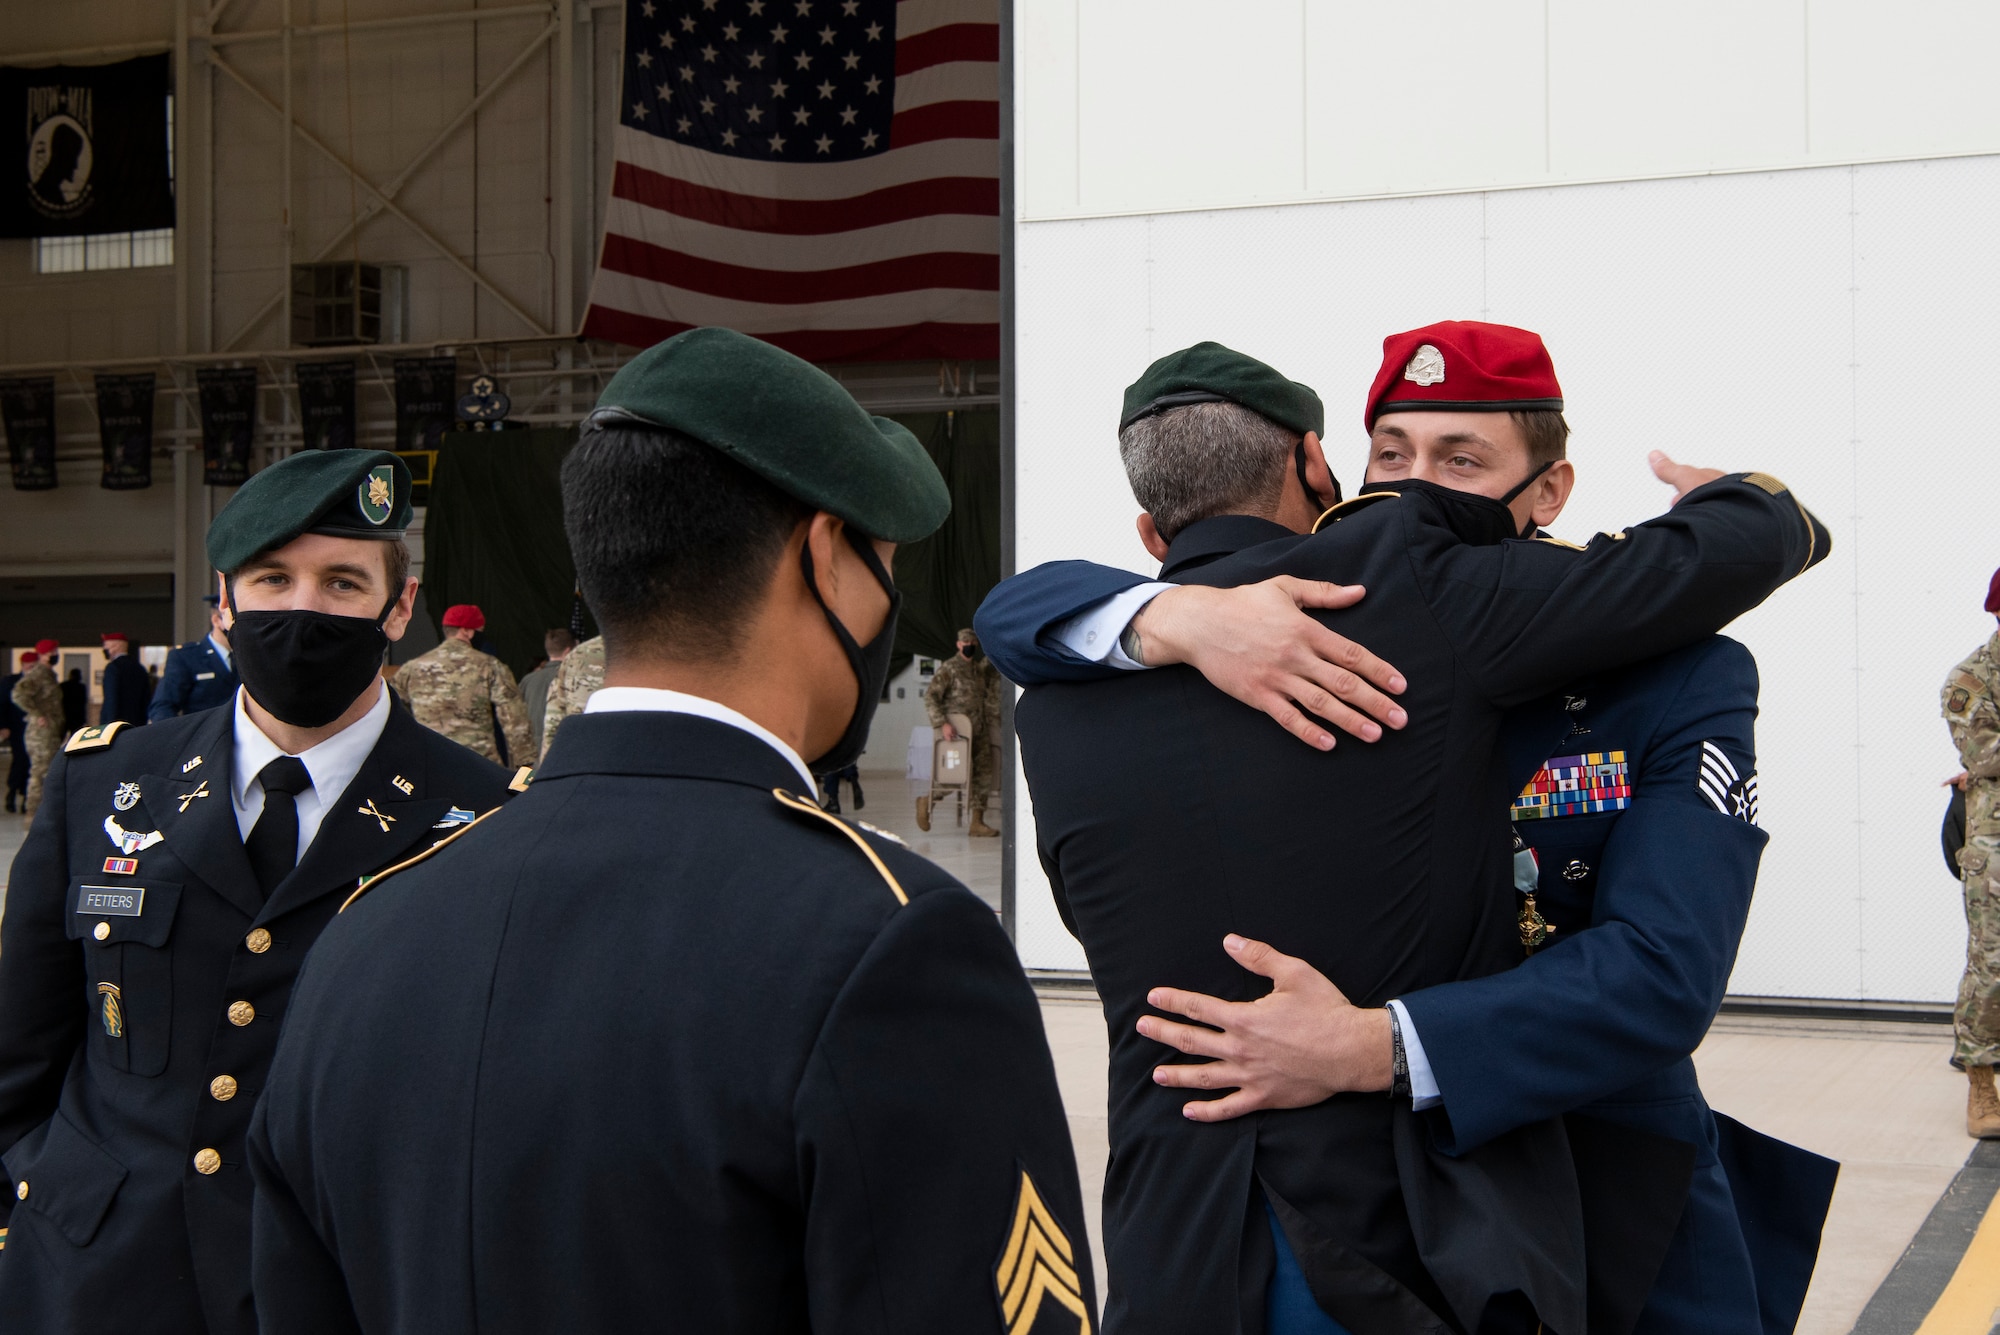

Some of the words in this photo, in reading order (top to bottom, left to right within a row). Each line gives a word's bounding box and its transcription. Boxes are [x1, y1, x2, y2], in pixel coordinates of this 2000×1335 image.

[27, 86, 60, 143] POW
[67, 86, 94, 141] MIA
[182, 755, 203, 773] U.S.
[391, 774, 415, 796] U.S.
[86, 893, 134, 909] FETTERS
